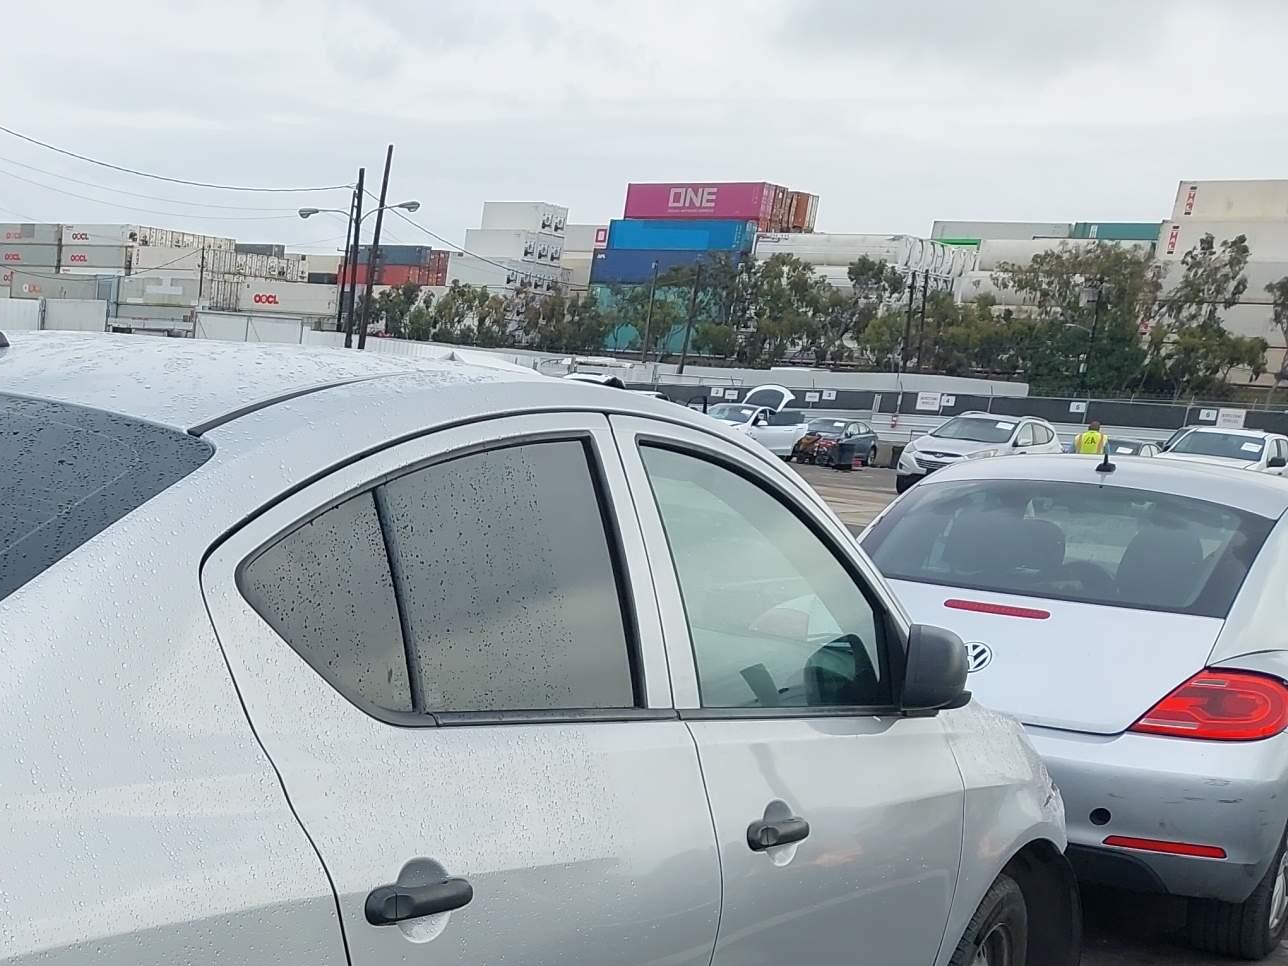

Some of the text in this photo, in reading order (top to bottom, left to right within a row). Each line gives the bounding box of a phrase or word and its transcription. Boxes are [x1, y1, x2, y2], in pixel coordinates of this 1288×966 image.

[668, 187, 718, 207] ONE
[72, 233, 89, 241] OOCL
[4, 253, 22, 261] OOCL
[70, 254, 88, 262] OOCL
[254, 294, 280, 305] OOCL
